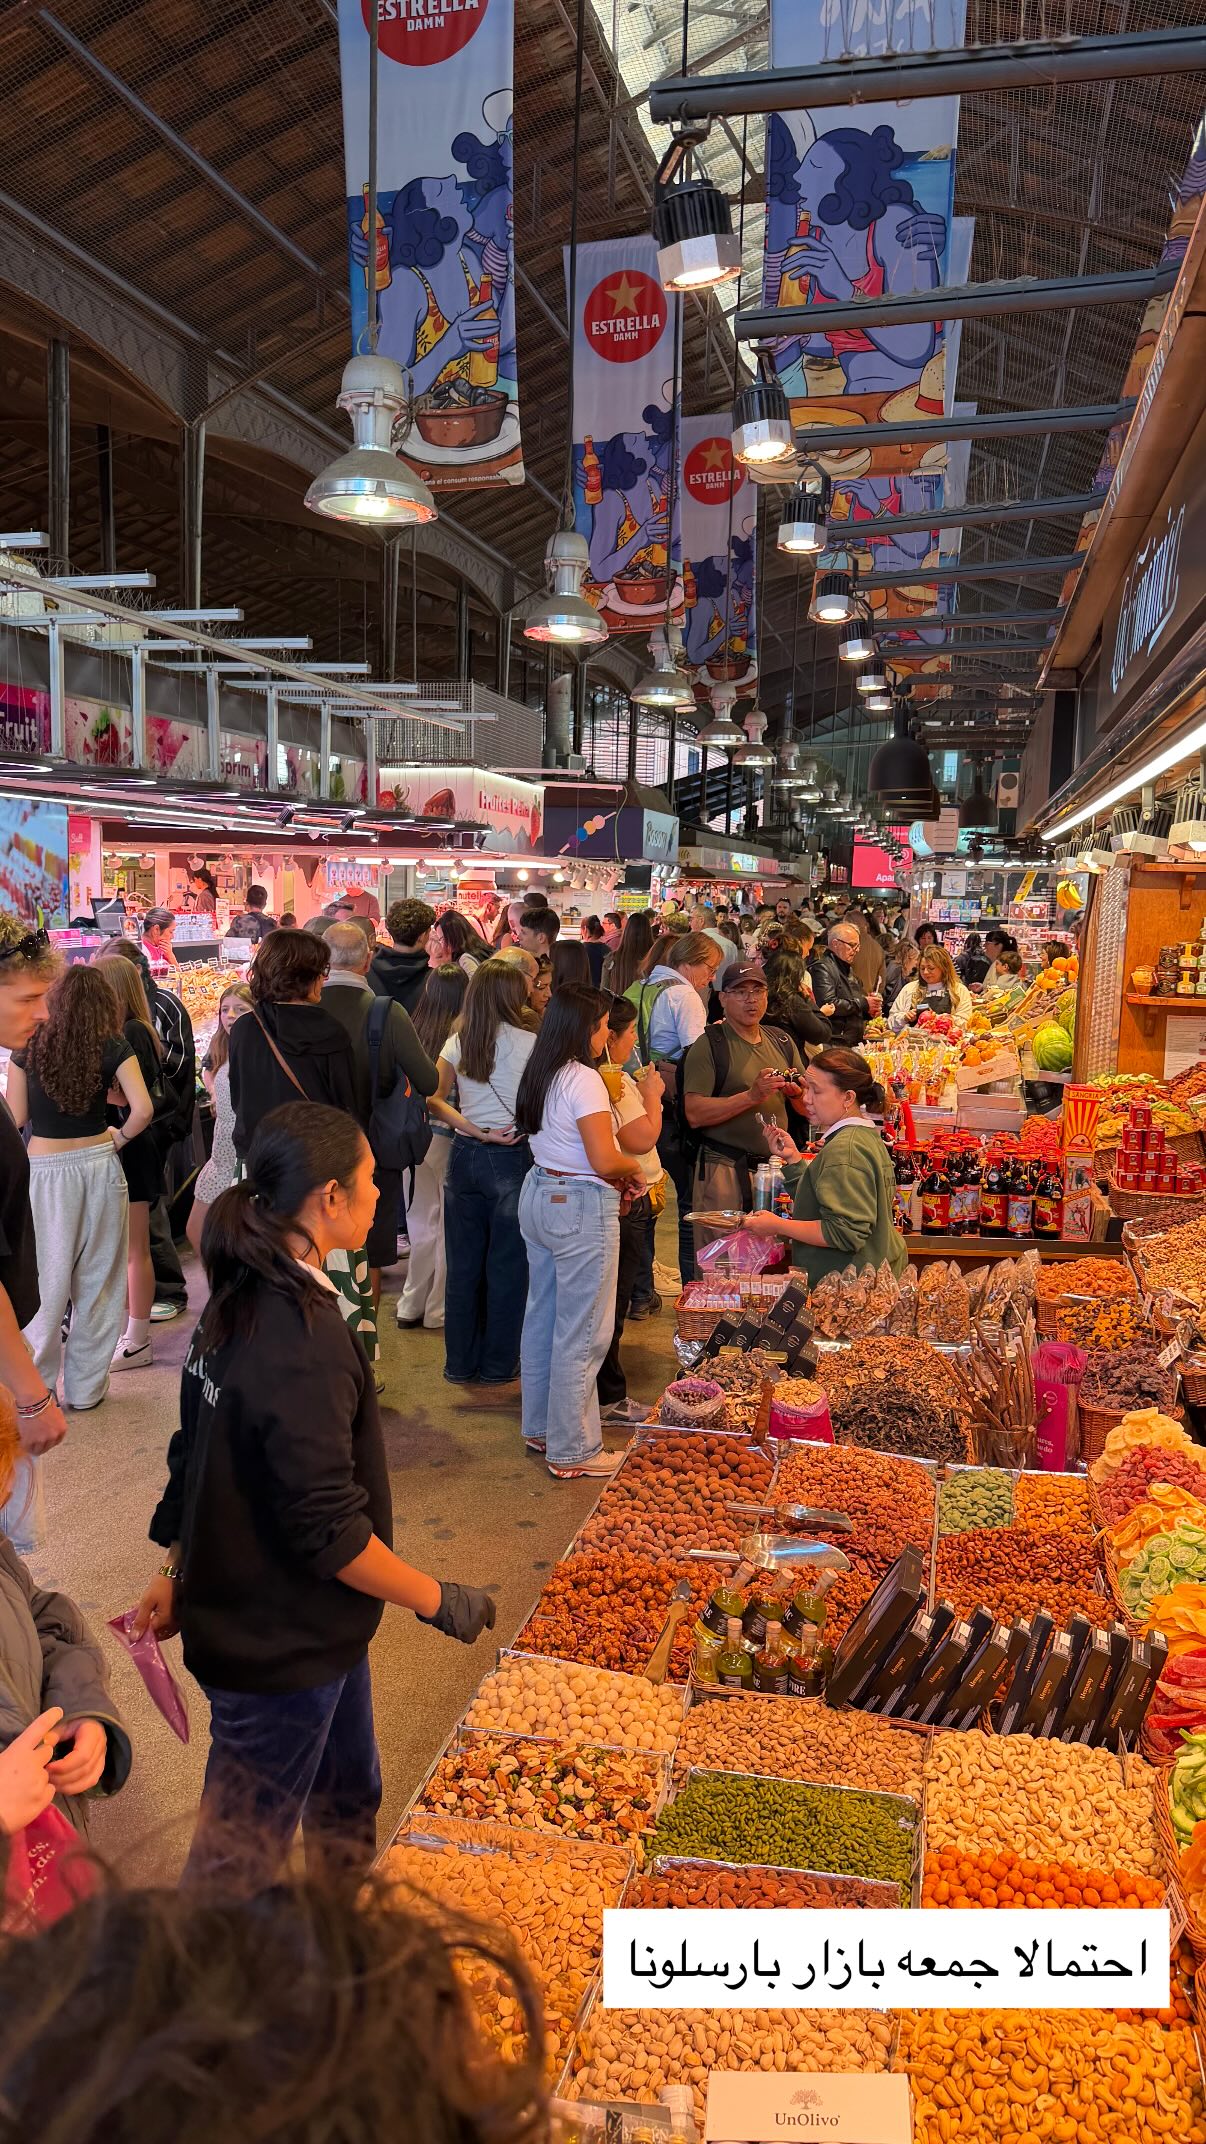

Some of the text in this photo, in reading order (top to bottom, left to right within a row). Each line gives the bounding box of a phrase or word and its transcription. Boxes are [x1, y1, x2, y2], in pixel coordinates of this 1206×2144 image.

[377, 0, 479, 21] ESTRELLA
[406, 15, 445, 32] DAMM
[591, 313, 661, 335] ESTRELLA
[613, 331, 639, 342] DAMM
[705, 481, 725, 490] DAMM
[0, 711, 38, 743] ruit
[459, 891, 482, 901] nutell
[1071, 1091, 1100, 1099] SANGRIA
[928, 1665, 945, 1685] Alemany
[968, 1668, 986, 1688] Alemany
[991, 1657, 1009, 1681] Alemany
[1100, 1663, 1113, 1691] Alemany
[1039, 1679, 1053, 1701] Alemany
[1080, 1676, 1094, 1701] Alemany
[1137, 1676, 1152, 1702] Alemany
[775, 2111, 840, 2127] UnOlivo
